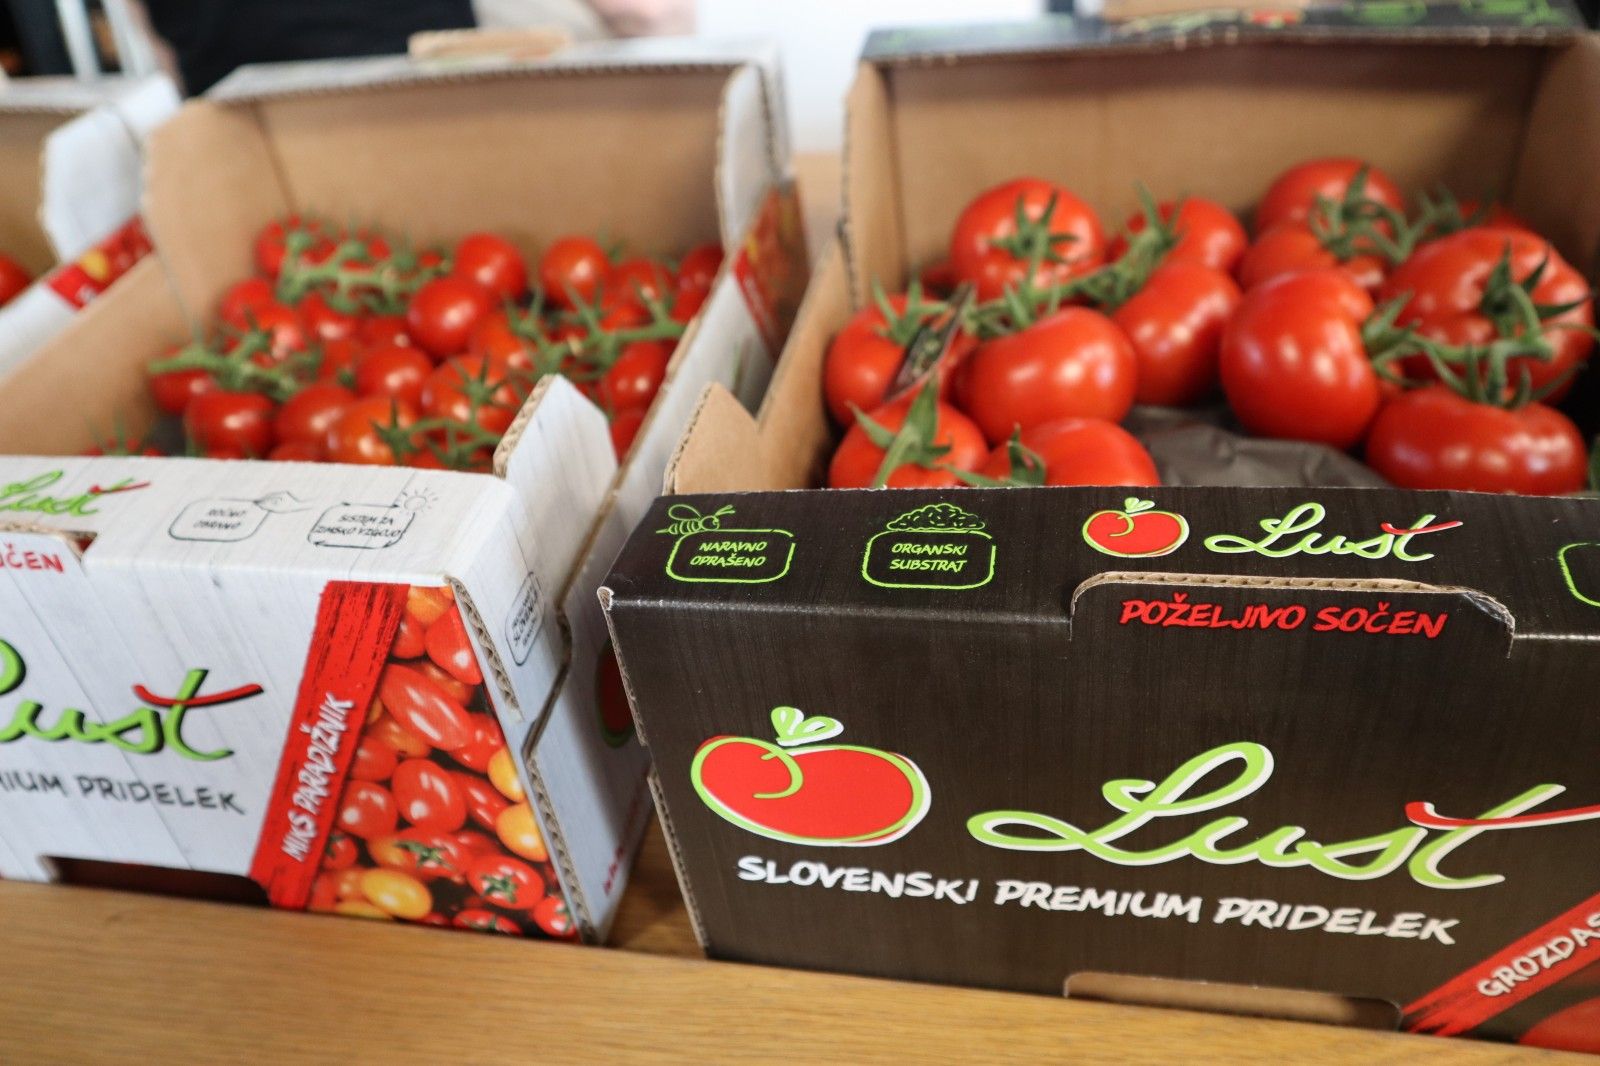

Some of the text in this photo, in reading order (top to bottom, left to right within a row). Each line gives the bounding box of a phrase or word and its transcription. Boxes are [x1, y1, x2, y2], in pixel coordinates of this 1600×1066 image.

[690, 552, 767, 568] OPRAŠENO
[699, 540, 768, 557] NARAVNO
[891, 542, 968, 556] ORGANSKI
[889, 558, 968, 573] SUBSTRAT
[1119, 592, 1449, 639] POŽELJIVO SOČEN
[0, 769, 246, 816] IUM PRIDELEK
[281, 692, 354, 862] MIKS PARADIŽNIK
[737, 855, 1460, 945] SLOVENSKI PREMIUM PRIDELEK
